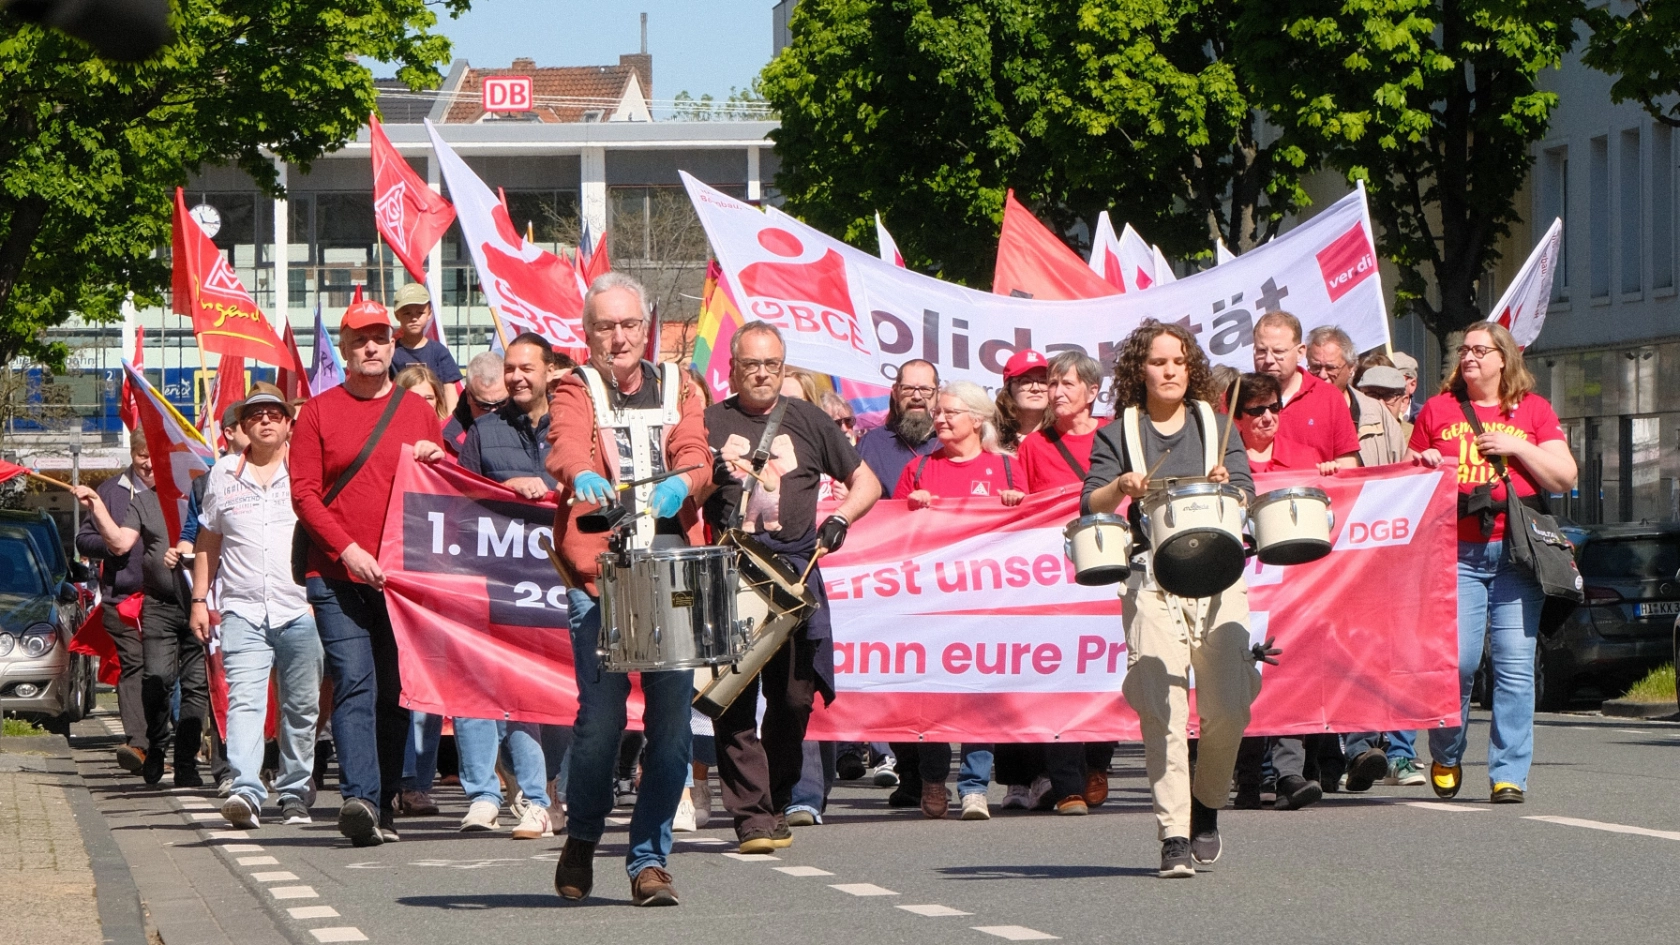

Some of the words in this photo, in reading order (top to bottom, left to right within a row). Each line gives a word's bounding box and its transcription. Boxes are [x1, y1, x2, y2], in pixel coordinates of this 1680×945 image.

[489, 82, 527, 106] DB
[427, 511, 461, 556] 1.
[1348, 517, 1410, 545] DGB
[833, 640, 927, 675] ann
[941, 641, 1063, 676] eure
